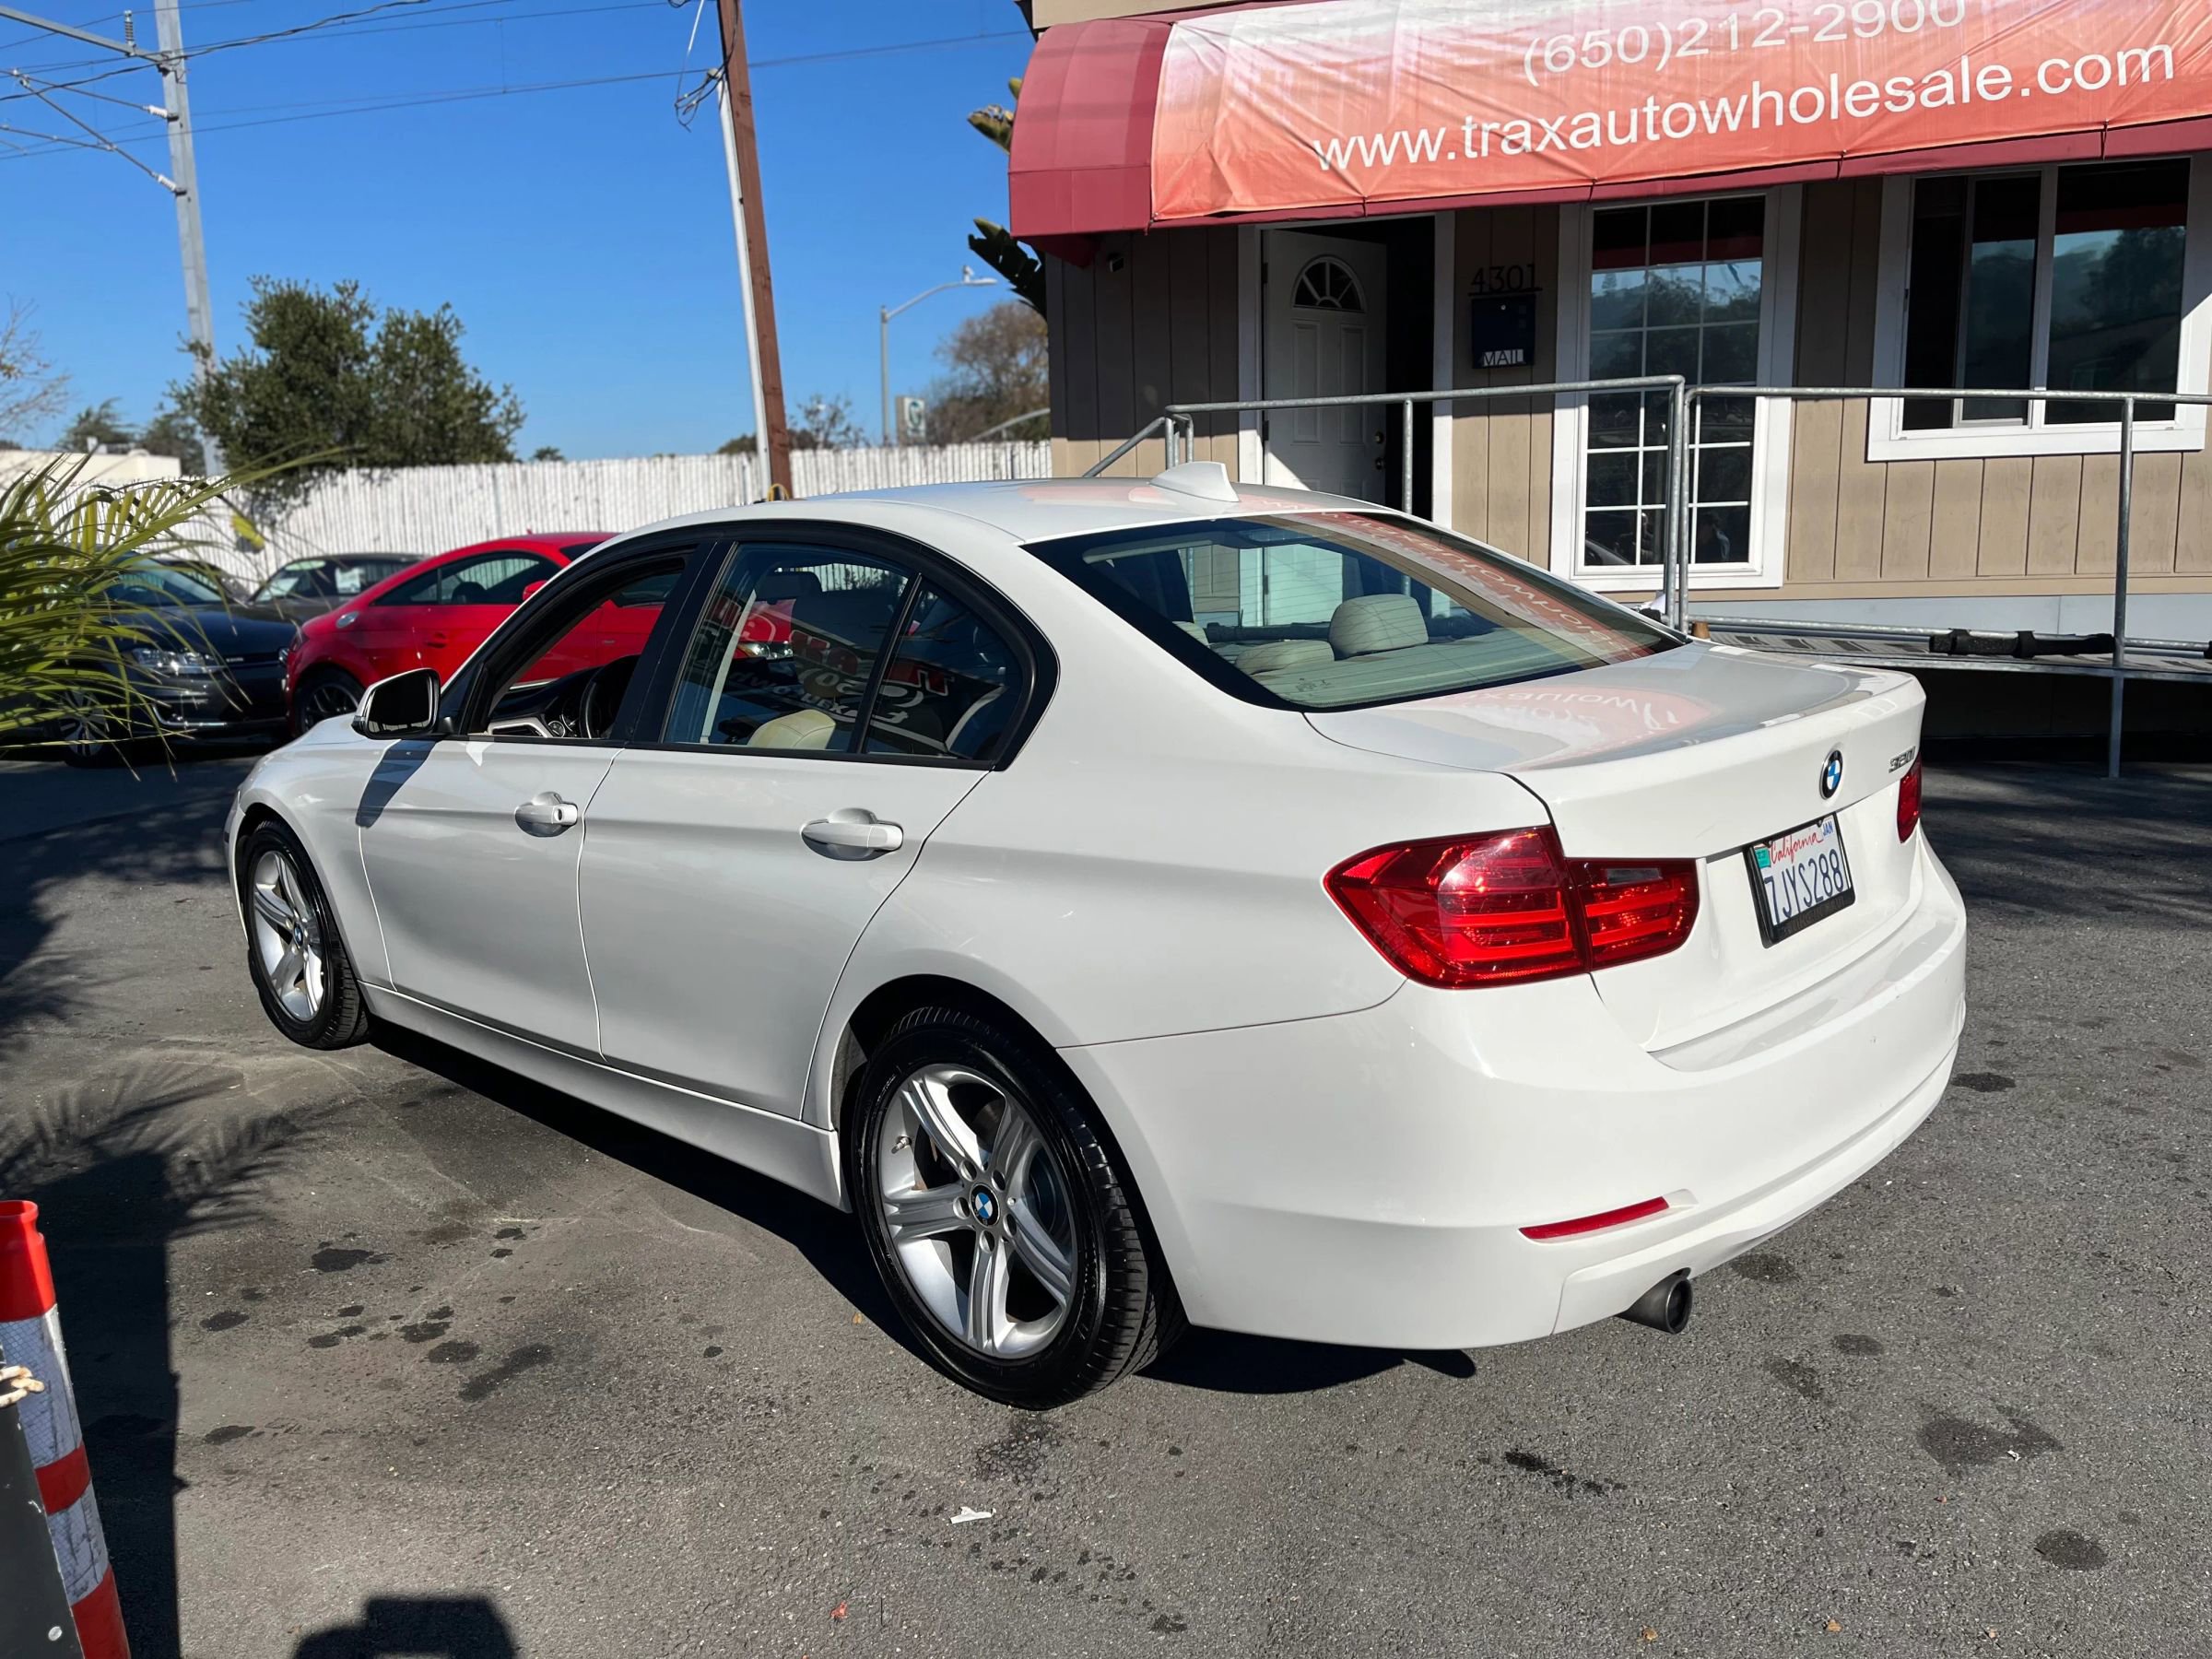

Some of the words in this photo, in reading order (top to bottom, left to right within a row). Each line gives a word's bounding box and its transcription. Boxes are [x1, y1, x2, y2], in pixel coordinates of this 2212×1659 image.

[1523, 0, 1967, 88] (650)212-2900
[1312, 43, 2174, 171] www.traxautowholesale.com
[1470, 263, 1536, 293] 4301
[1482, 348, 1526, 367] MAIL
[1822, 820, 1834, 837] JAN
[1770, 831, 1824, 865] California
[1763, 848, 1844, 924] 7JYS288
